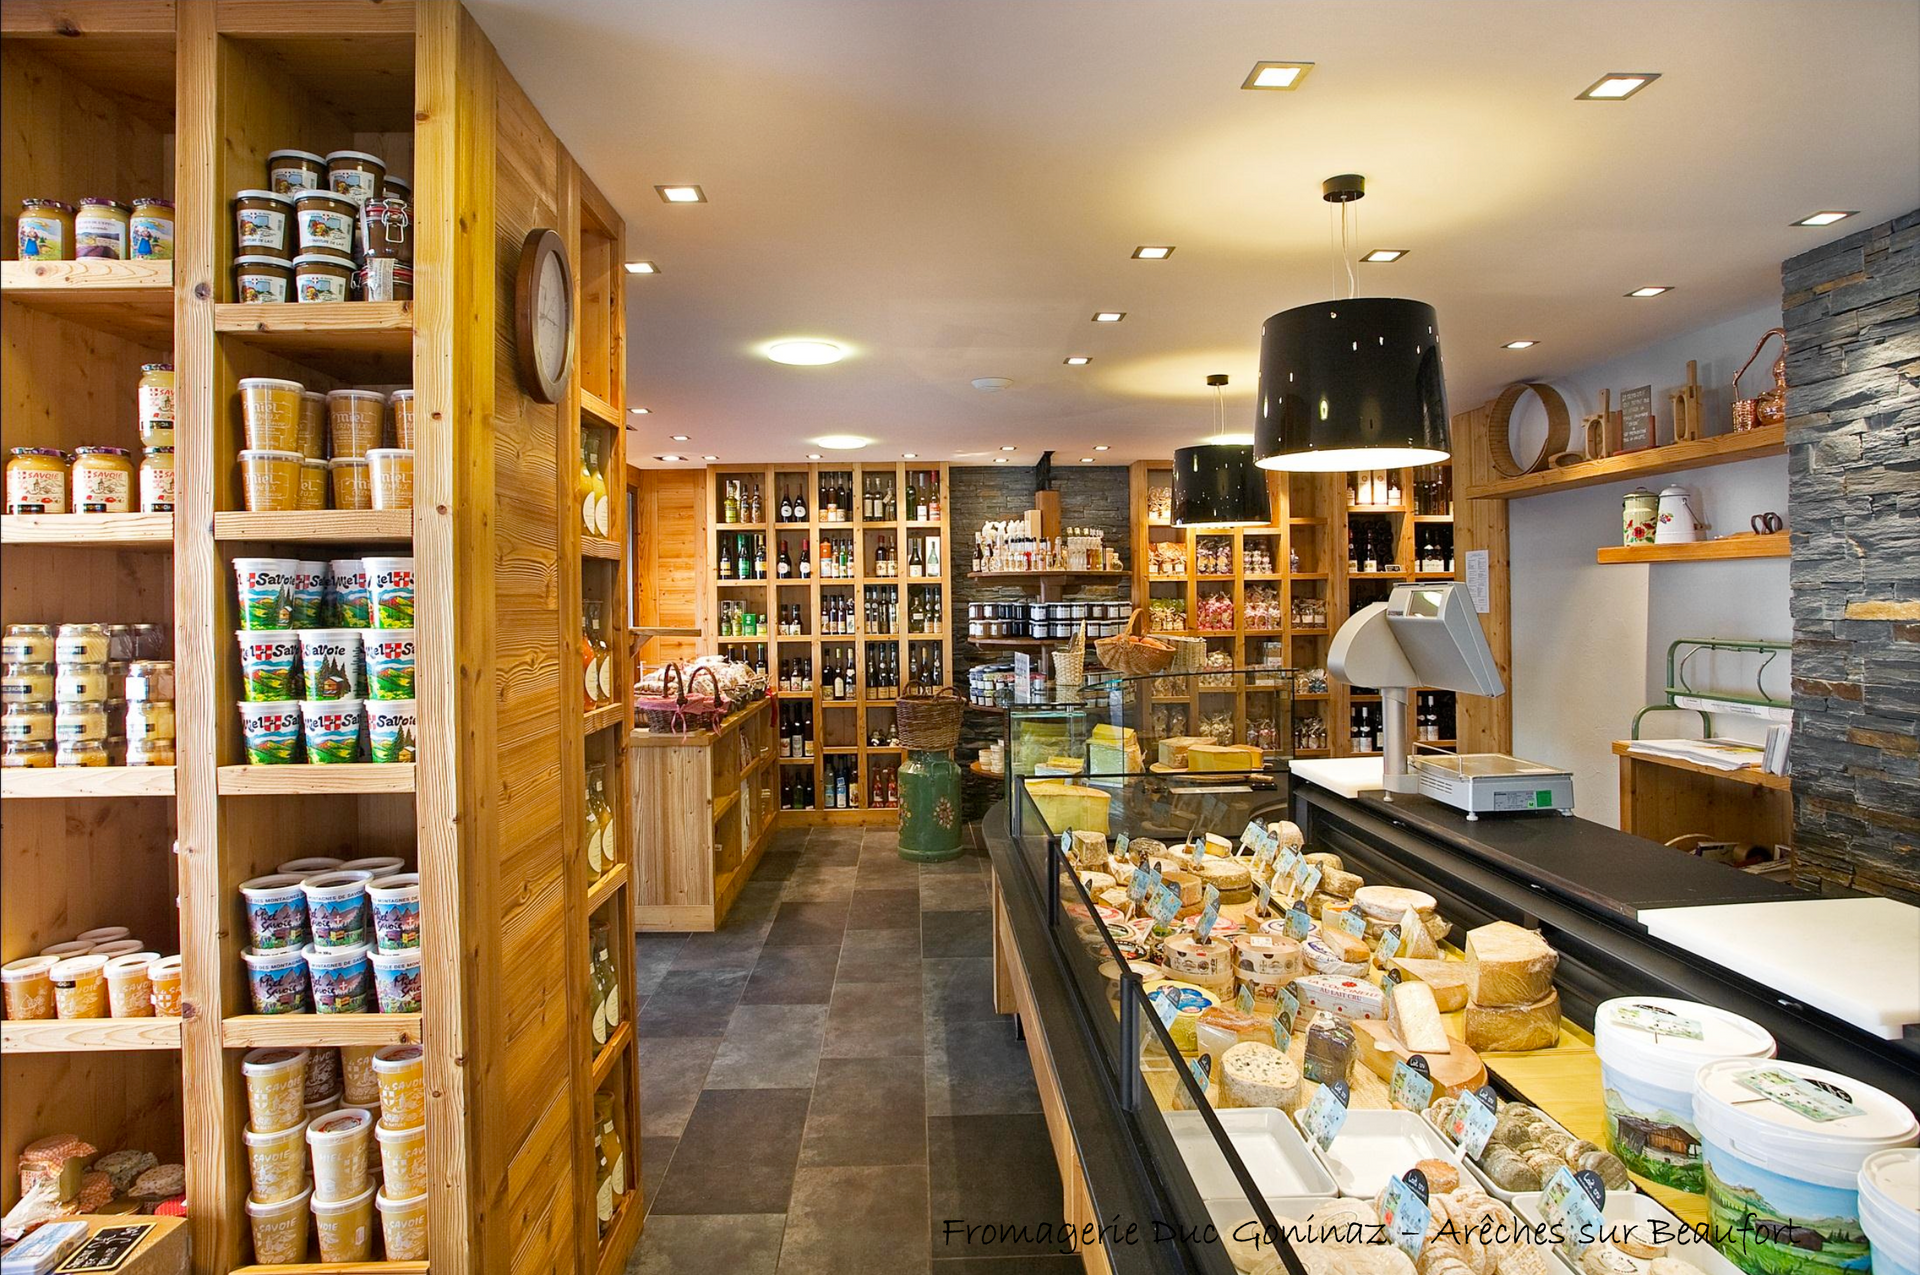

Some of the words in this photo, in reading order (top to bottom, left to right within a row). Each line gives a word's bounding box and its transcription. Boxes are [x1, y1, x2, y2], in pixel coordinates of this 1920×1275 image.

[28, 472, 59, 480] SAVOIE
[93, 471, 123, 479] SAVOIE
[256, 573, 295, 586] Savoie
[305, 644, 346, 656] Savoie
[1330, 990, 1347, 998] LAIT
[1347, 993, 1363, 1001] CRU
[265, 1075, 302, 1092] SAVOIE
[253, 1149, 291, 1163] SAVOIE
[259, 1217, 297, 1232] SAVOIE
[389, 1215, 425, 1229] SAVOIE
